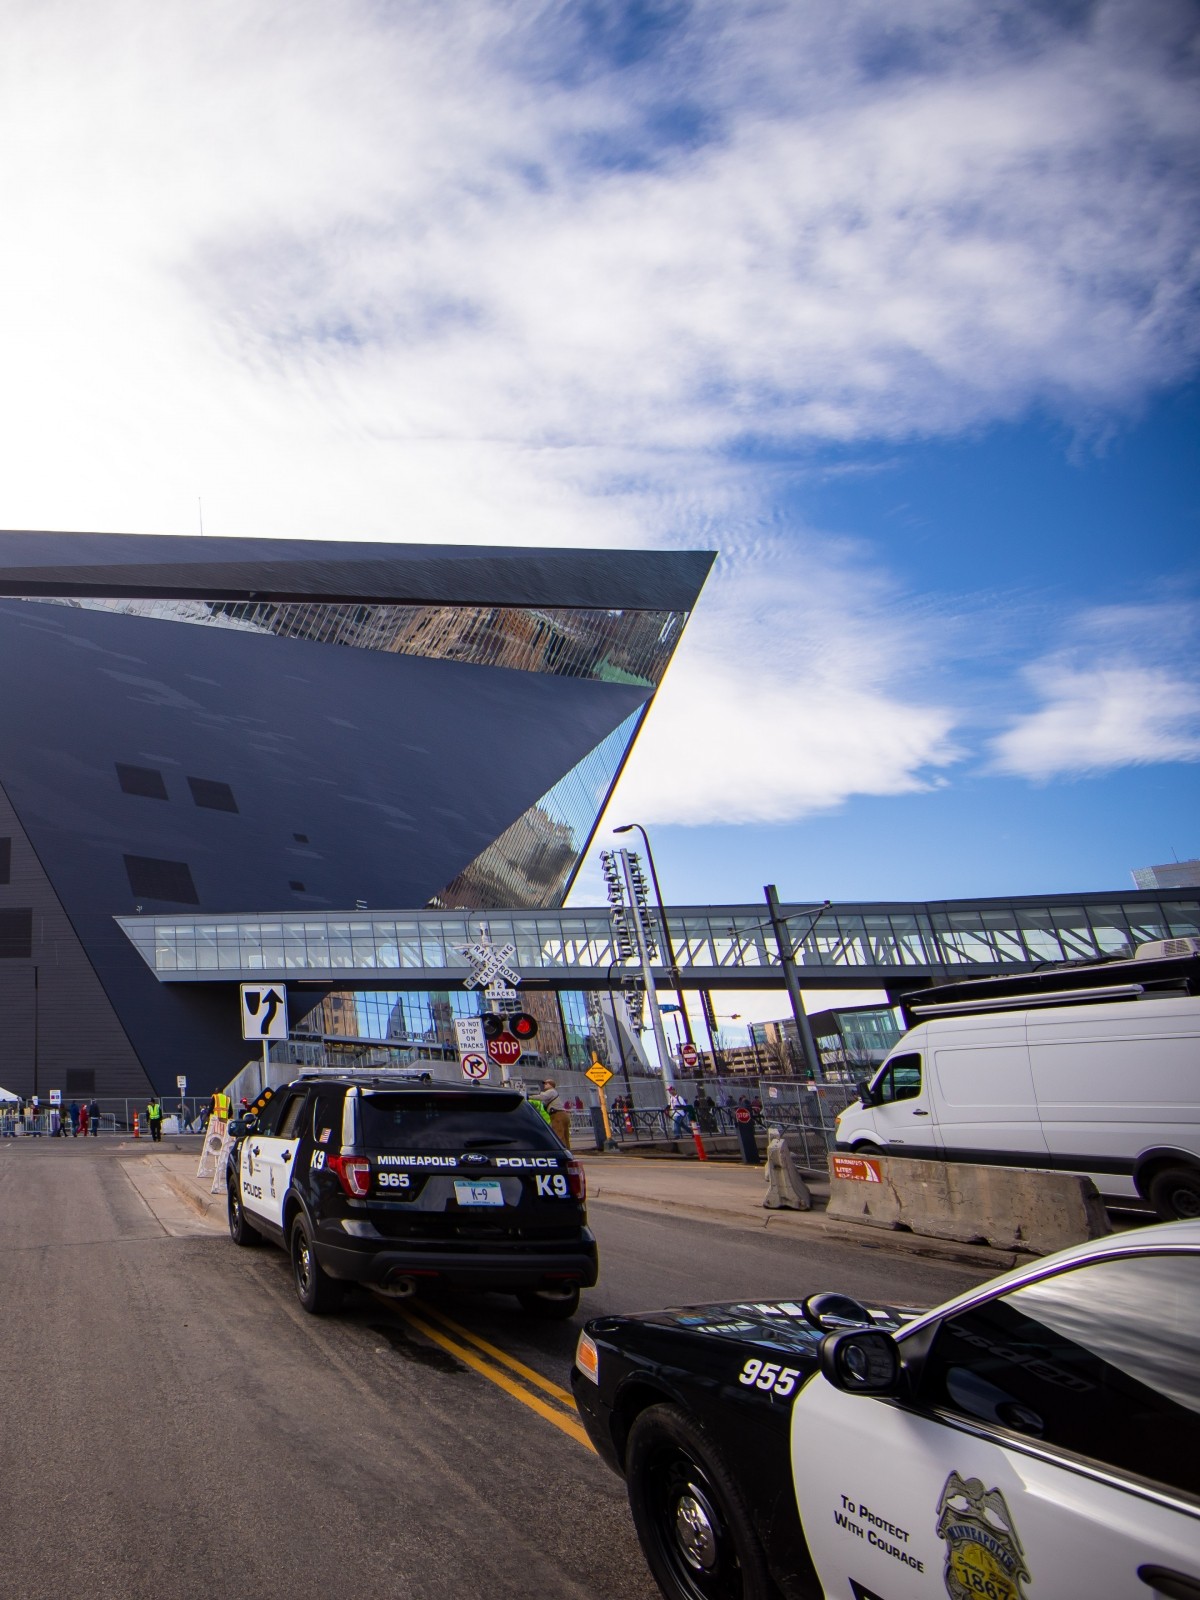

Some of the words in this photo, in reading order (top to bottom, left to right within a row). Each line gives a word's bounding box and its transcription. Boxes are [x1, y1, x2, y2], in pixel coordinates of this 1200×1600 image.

[474, 945, 492, 963] RAIL
[499, 965, 518, 983] ROAD
[479, 945, 514, 983] CROSSING
[496, 981, 503, 989] 2
[490, 1041, 519, 1054] STOP
[310, 1149, 325, 1170] K9
[377, 1155, 457, 1167] MINNEAPOLIS
[495, 1157, 558, 1168] POLICE
[378, 1172, 410, 1187] 965
[535, 1174, 568, 1196] K9
[243, 1181, 262, 1200] POLICE
[470, 1188, 488, 1200] K-9
[738, 1358, 801, 1396] 955
[947, 1524, 1014, 1568] MINNEAPOLIS
